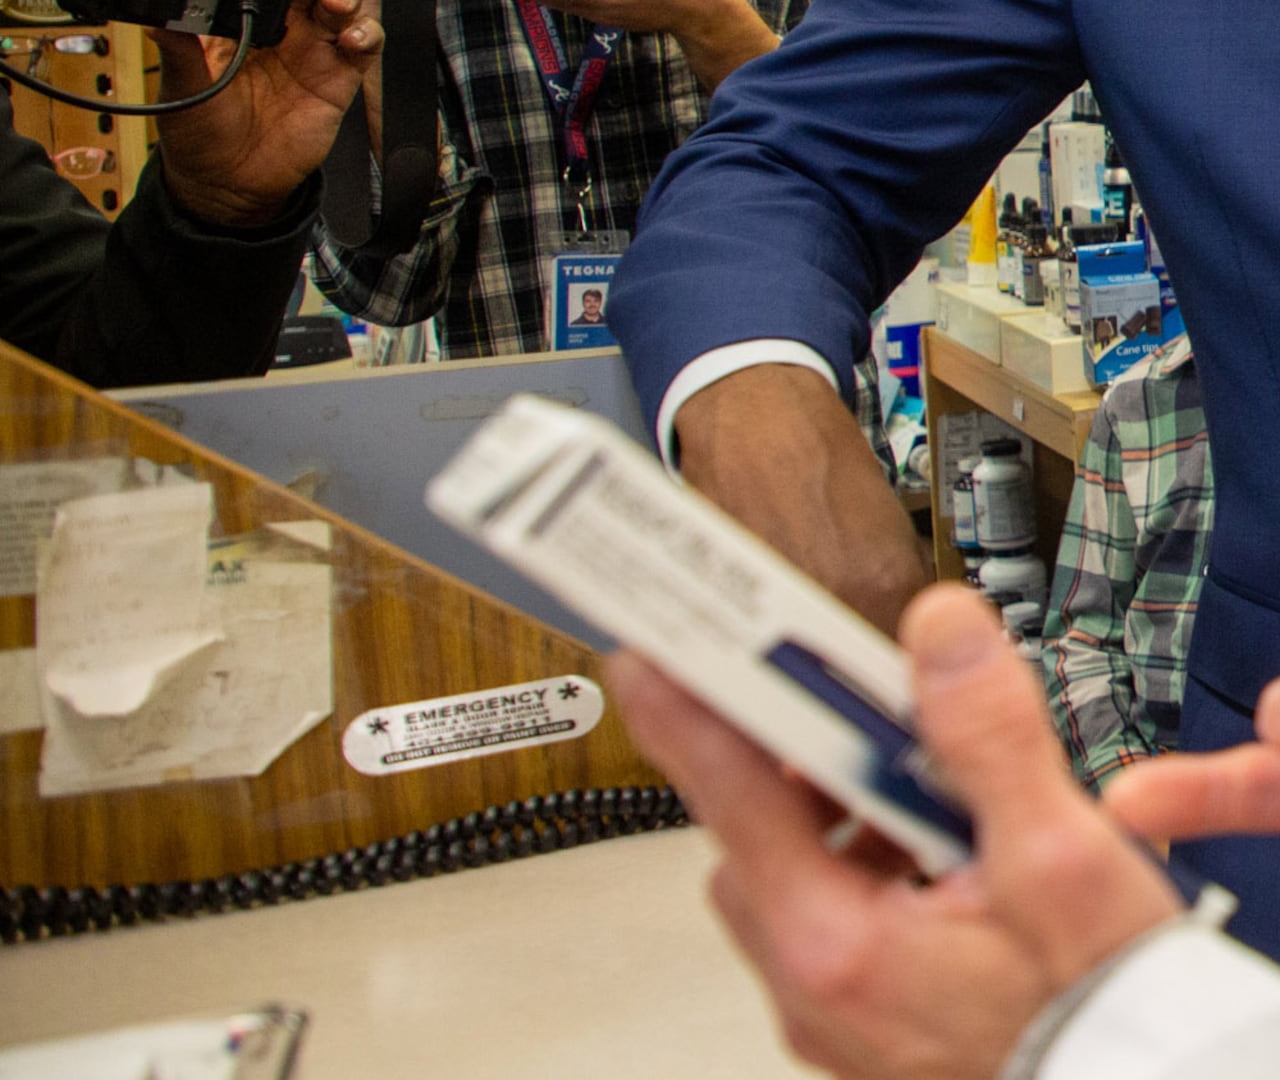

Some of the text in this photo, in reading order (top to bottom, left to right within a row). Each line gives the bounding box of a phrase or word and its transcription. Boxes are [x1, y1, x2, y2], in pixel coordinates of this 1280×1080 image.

[519, 1, 558, 72] AMPIONS
[563, 266, 615, 276] TEGNA
[1116, 344, 1140, 356] Cane
[404, 687, 549, 724] EMERGENCY
